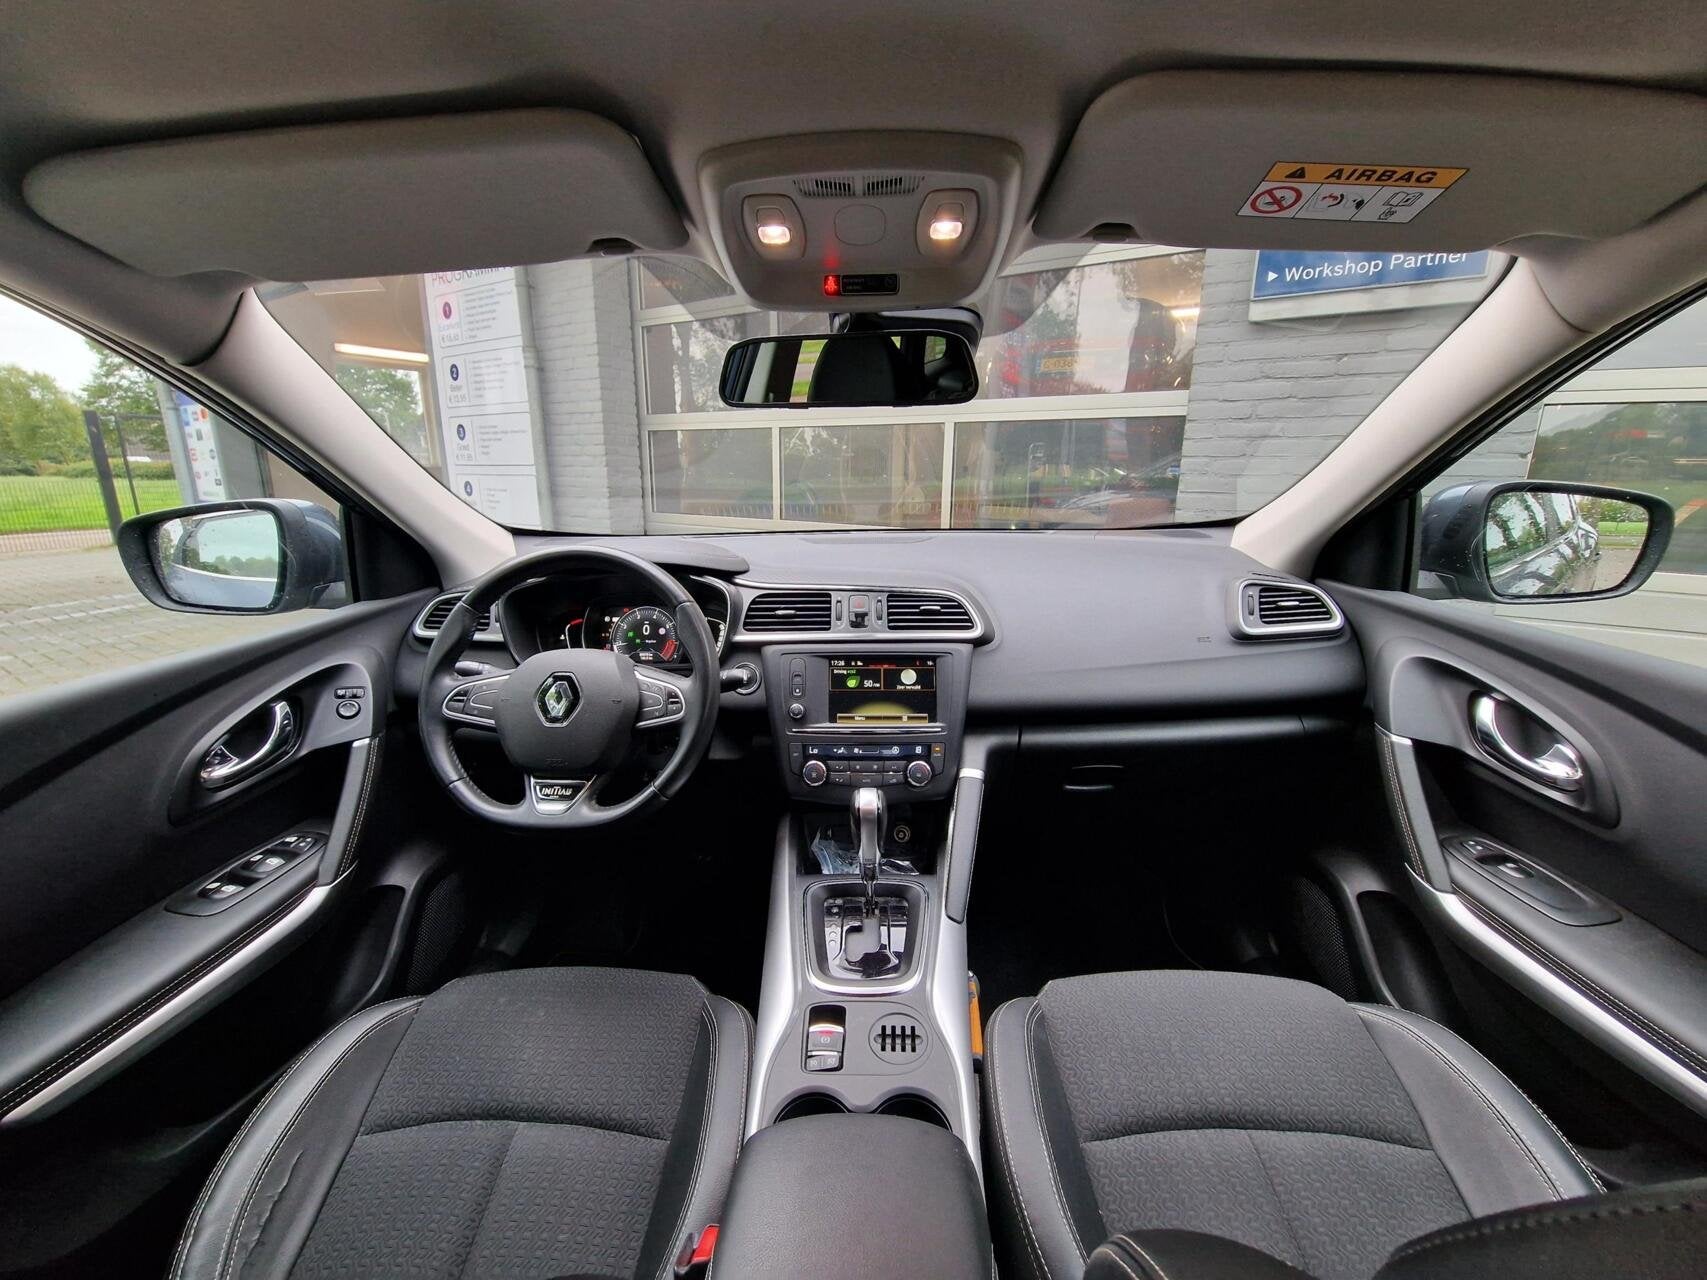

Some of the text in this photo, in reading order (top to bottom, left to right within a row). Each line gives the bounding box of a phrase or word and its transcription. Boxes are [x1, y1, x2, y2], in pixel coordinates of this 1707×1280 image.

[1324, 167, 1437, 184] AIRBAG
[1285, 252, 1466, 282] Workshop Partner
[642, 624, 650, 636] 0
